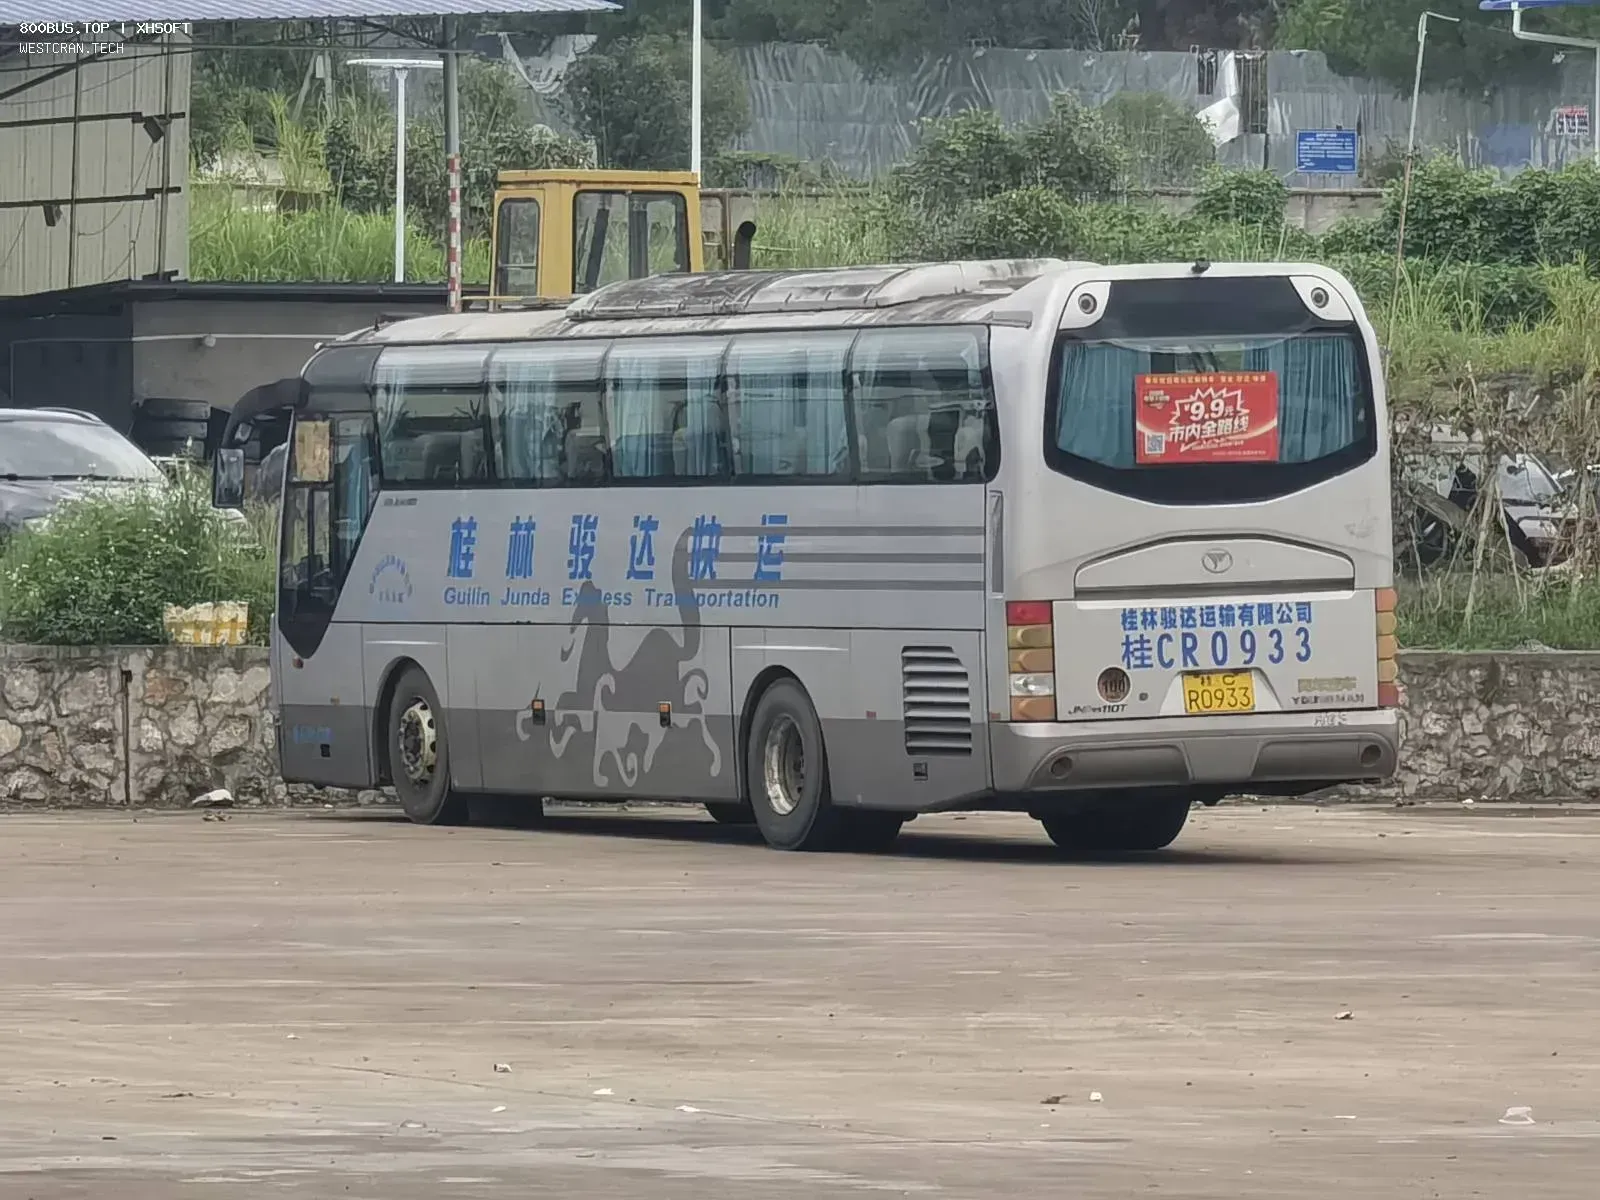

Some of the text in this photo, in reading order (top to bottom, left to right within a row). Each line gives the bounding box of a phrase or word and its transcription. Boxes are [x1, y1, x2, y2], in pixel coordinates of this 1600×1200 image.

[1169, 415, 1249, 443] 市内全路线
[447, 514, 789, 581] 桂林骏达快运
[444, 586, 780, 608] Guilin Junda Eess Traportation
[1120, 601, 1312, 632] 桂林骏达运输有限公司
[1121, 626, 1312, 670] 桂CR0933
[1188, 686, 1251, 710] R0933
